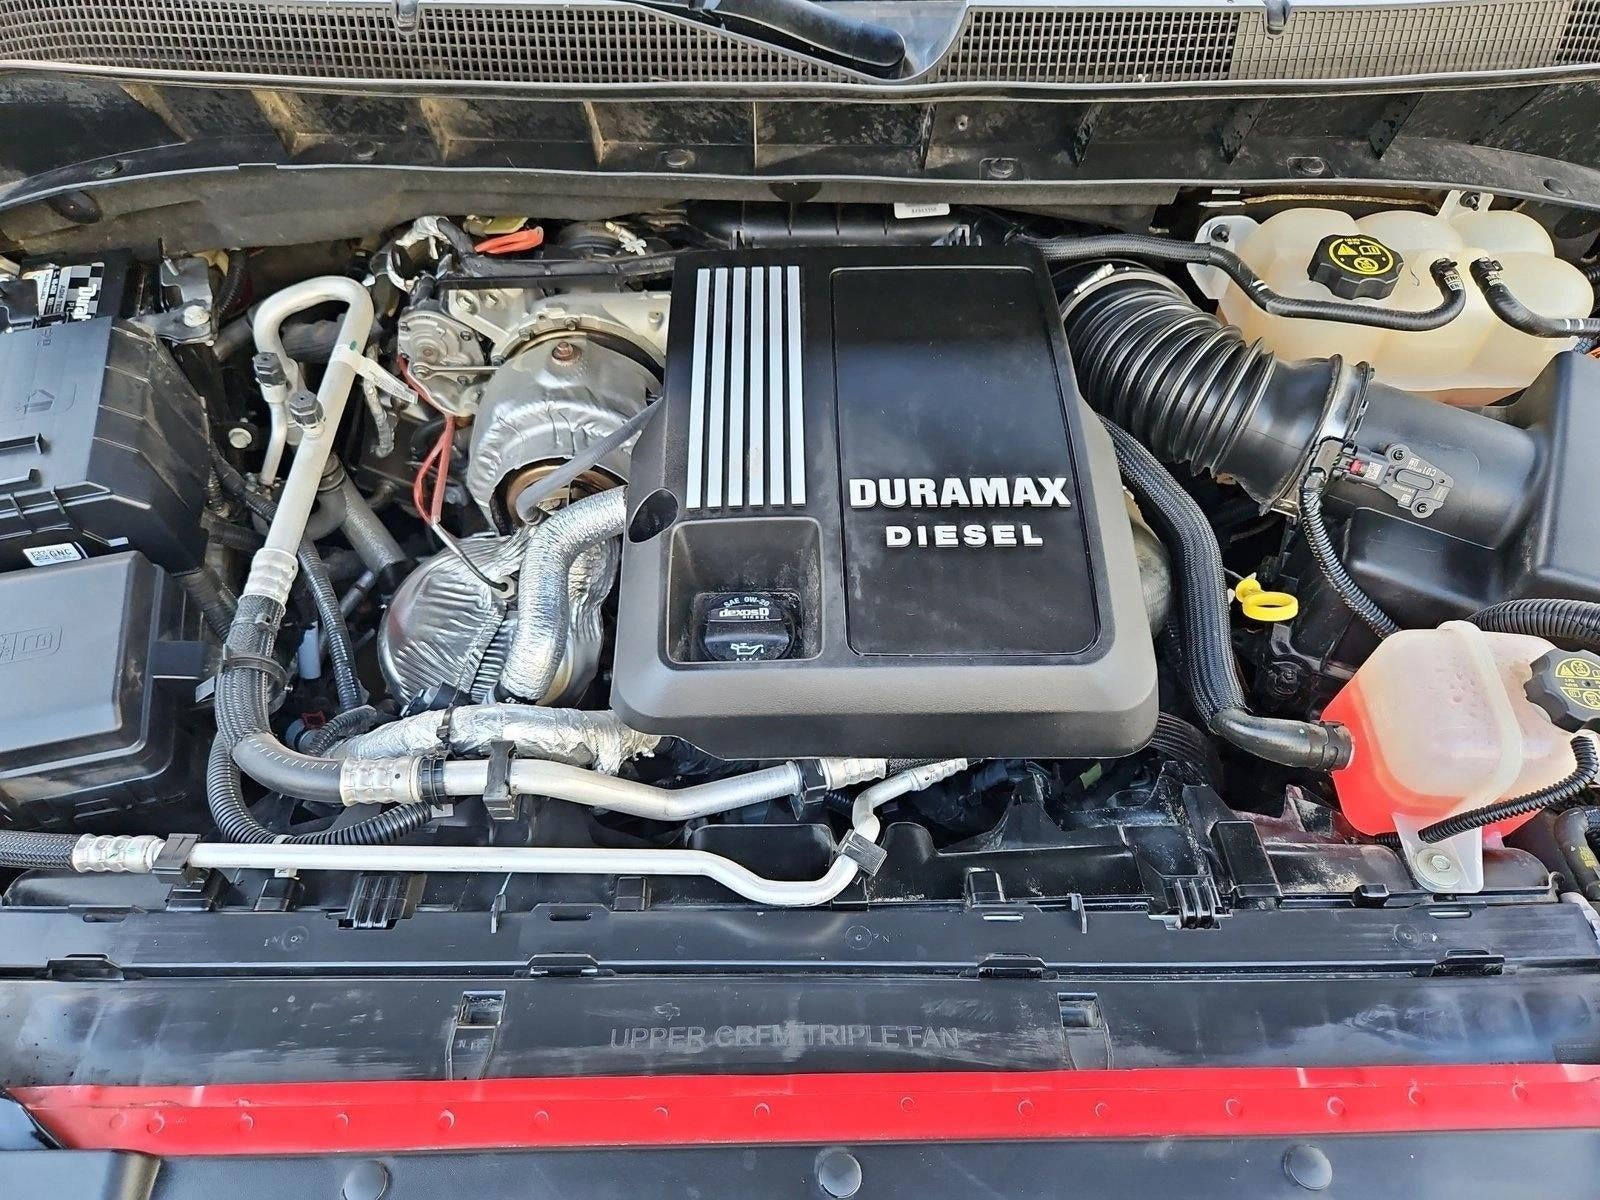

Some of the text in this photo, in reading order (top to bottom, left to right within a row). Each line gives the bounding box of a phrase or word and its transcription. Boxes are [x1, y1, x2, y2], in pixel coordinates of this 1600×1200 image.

[73, 283, 97, 321] Dural
[849, 477, 1072, 508] DURAMAX
[885, 524, 1044, 548] DIESEL
[724, 596, 770, 607] SAE 0W-20
[610, 1024, 959, 1049] UPPER CRFM TRIPLE FAN
